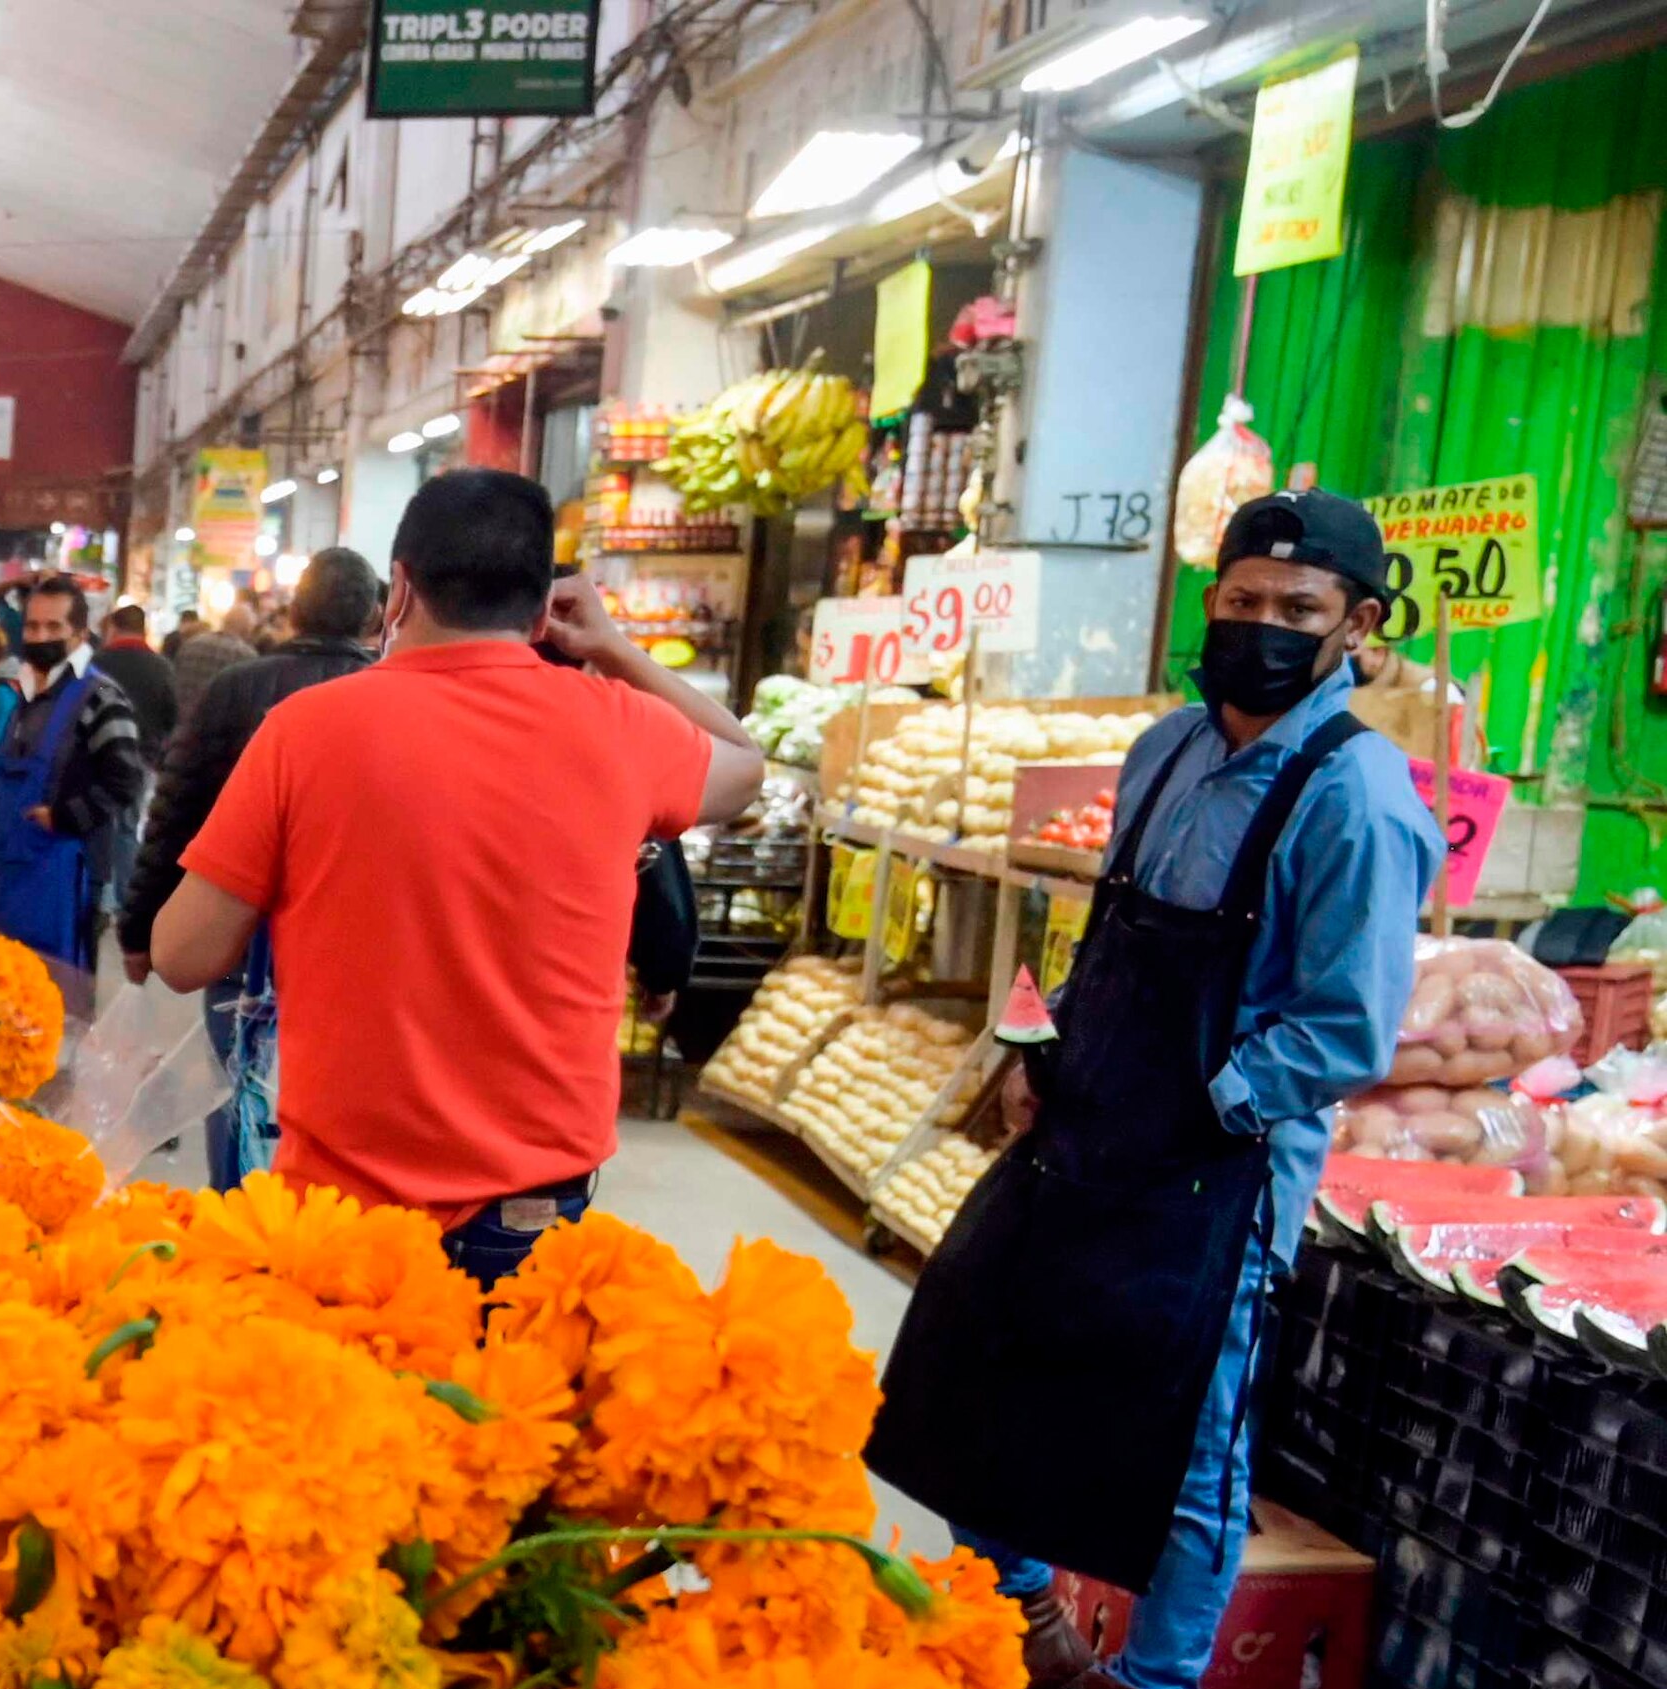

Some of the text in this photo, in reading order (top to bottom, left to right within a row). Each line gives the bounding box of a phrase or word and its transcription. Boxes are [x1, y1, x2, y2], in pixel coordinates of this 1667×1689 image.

[383, 9, 590, 41] TRIPL3 PODER
[1370, 483, 1492, 518] ITOMATE
[1383, 510, 1527, 543] VERNADERO
